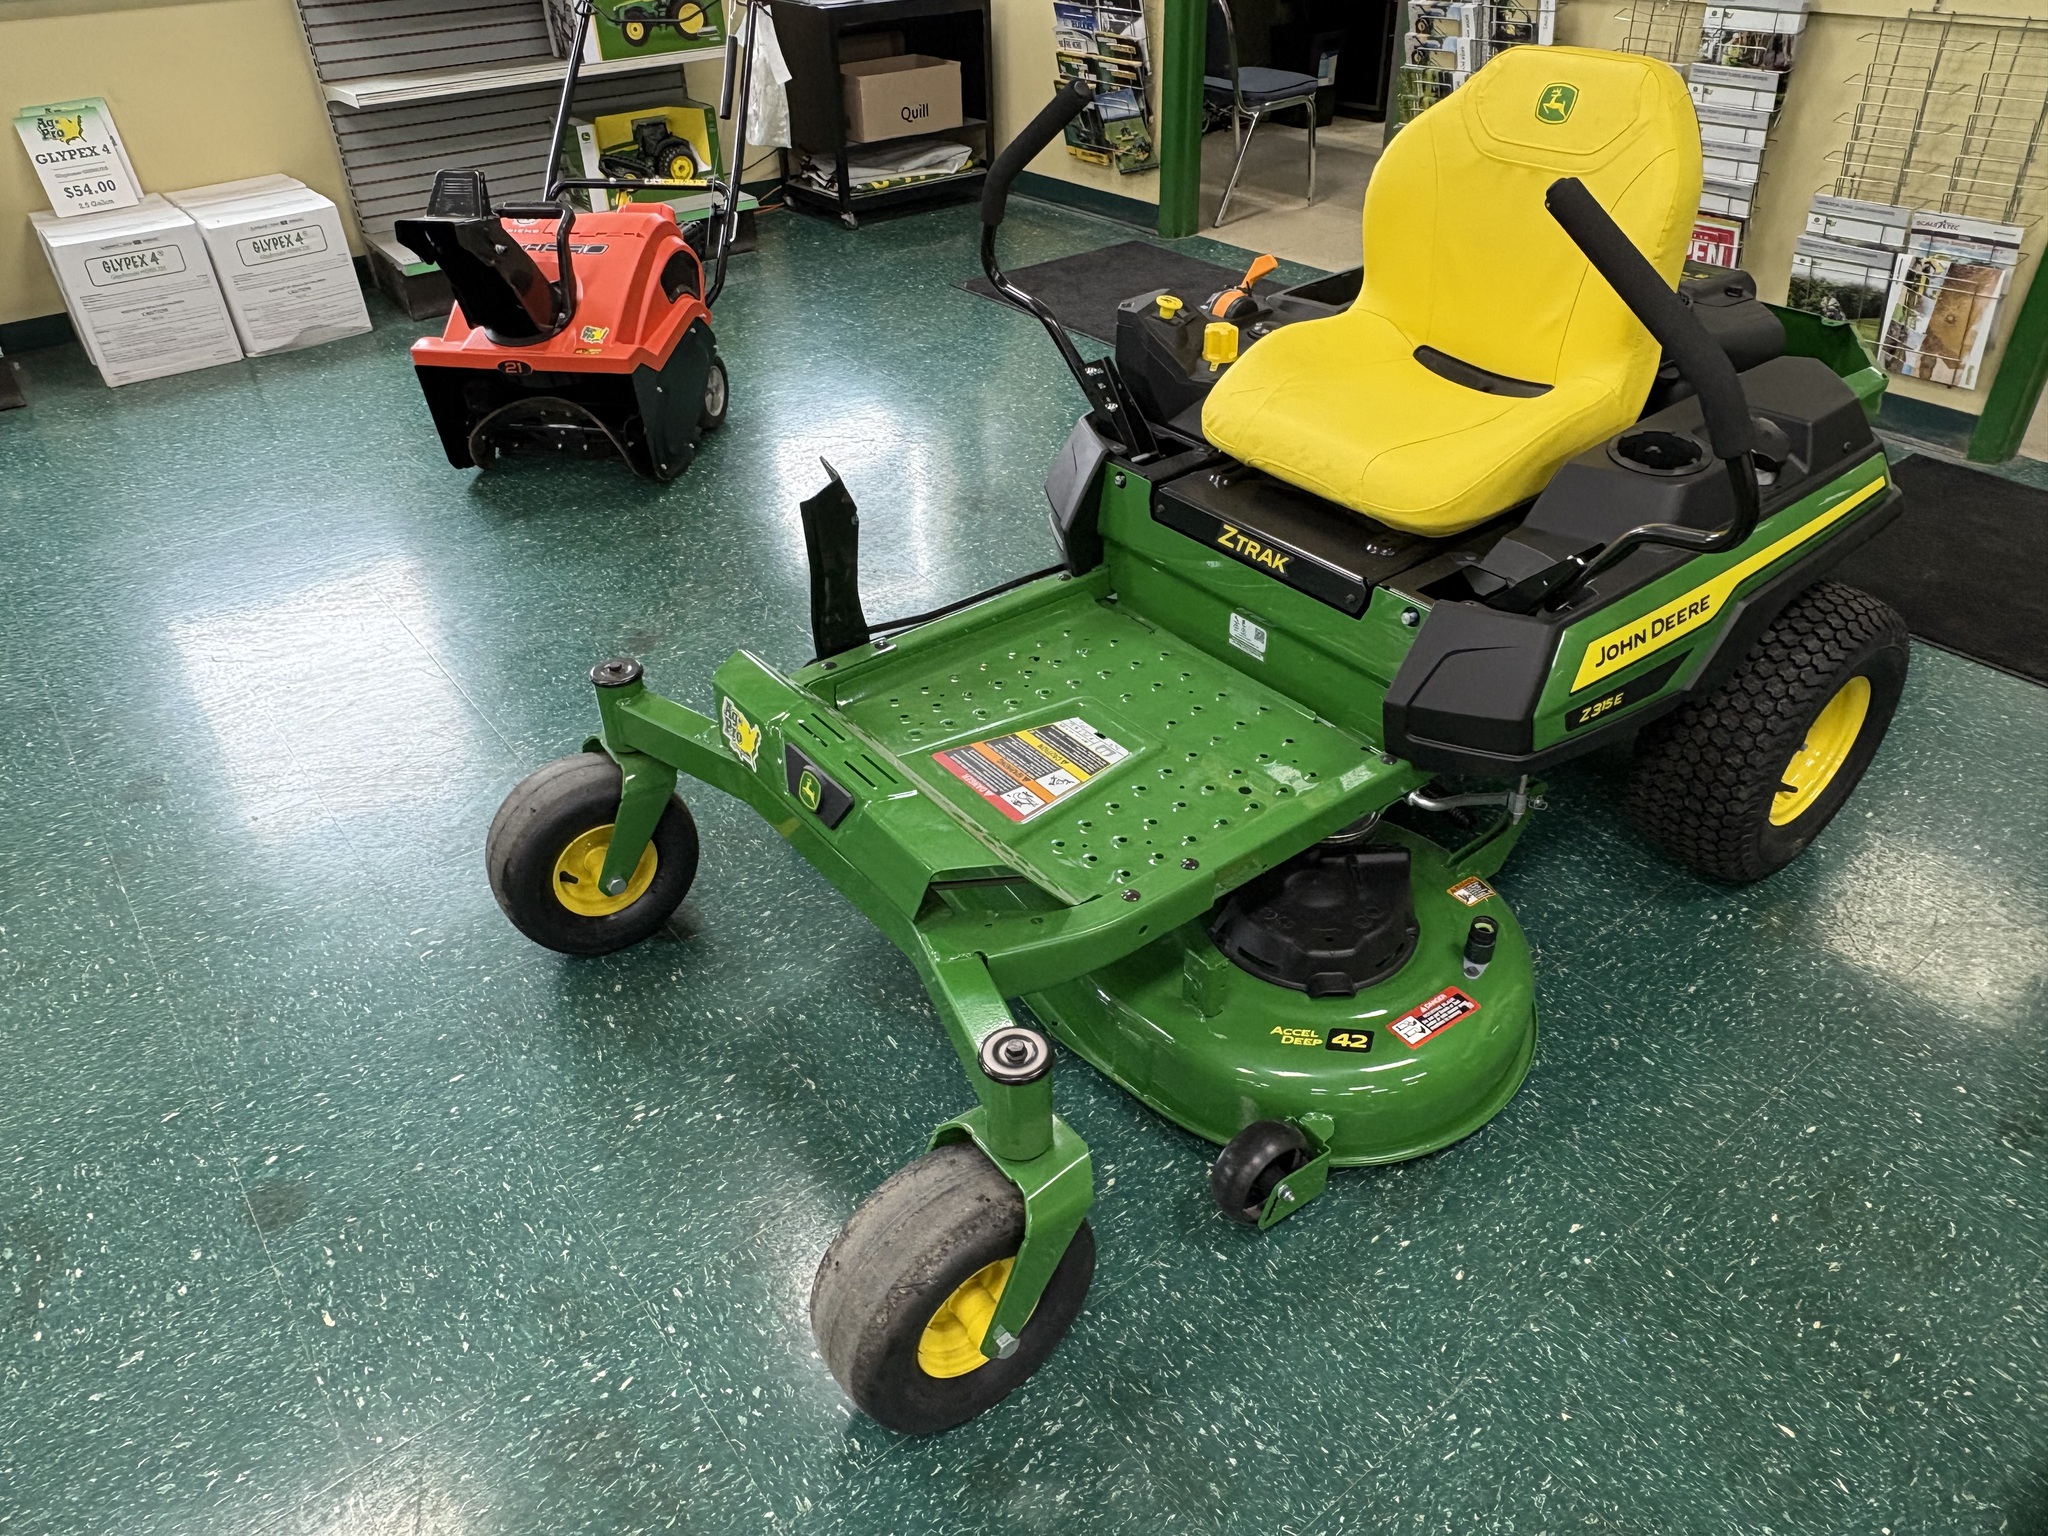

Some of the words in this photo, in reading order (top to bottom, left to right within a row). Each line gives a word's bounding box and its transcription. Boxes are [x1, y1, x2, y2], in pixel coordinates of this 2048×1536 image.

[901, 103, 929, 123] Quill
[35, 146, 101, 165] GLYPEX
[102, 144, 111, 155] 4
[64, 180, 117, 199] $54.00
[252, 233, 294, 254] GLYPEX
[102, 253, 148, 274] GLYPEX
[504, 362, 523, 374] 21
[1217, 524, 1290, 574] ZTRAK
[1595, 629, 1647, 668] JOHN
[1652, 594, 1711, 639] DEERE
[1579, 692, 1624, 723] Z315E
[1270, 1026, 1319, 1037] ACCEL
[1281, 1036, 1323, 1046] DEEP
[1331, 1033, 1368, 1048] 42
